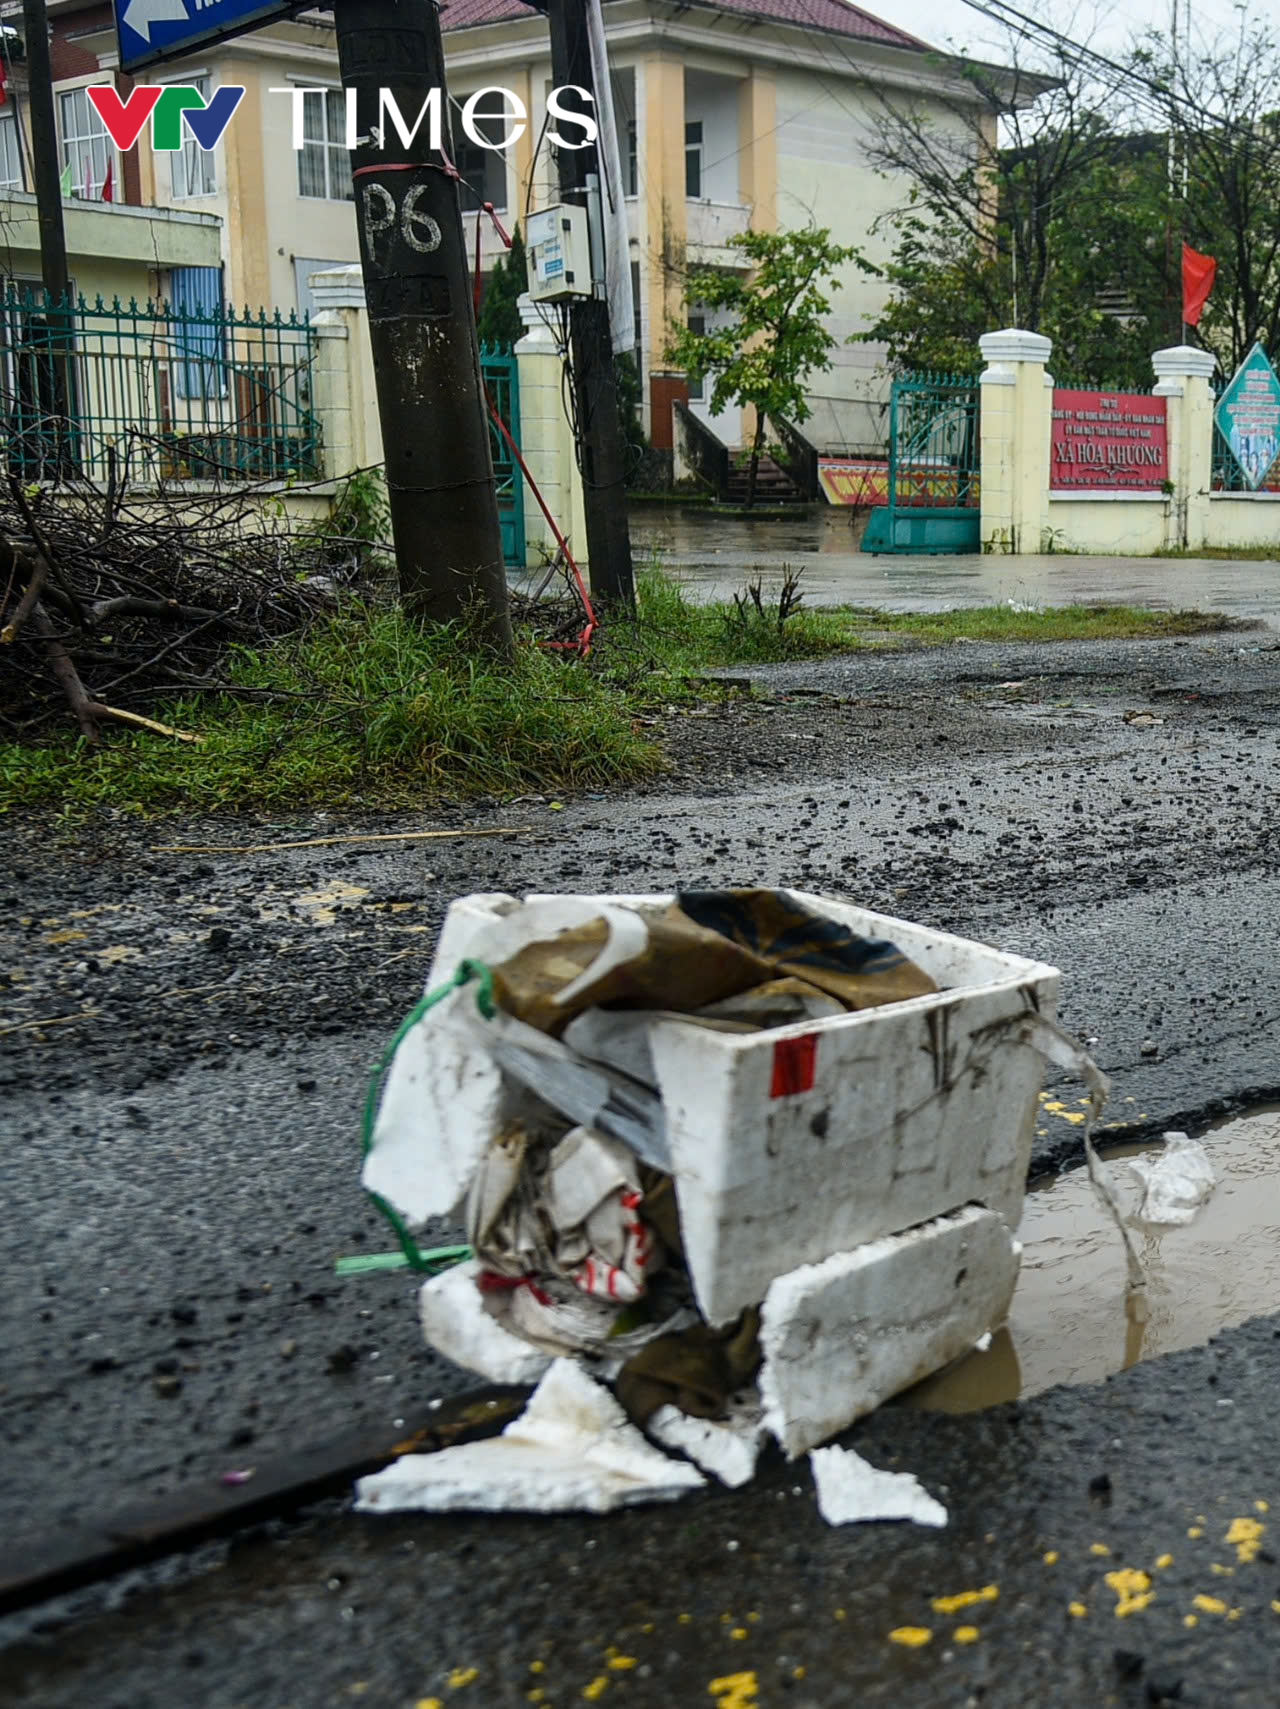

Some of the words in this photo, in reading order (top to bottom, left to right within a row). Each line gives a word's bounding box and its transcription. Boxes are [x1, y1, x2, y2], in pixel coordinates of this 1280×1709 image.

[362, 183, 442, 262] P6
[1056, 438, 1074, 463] XÃ
[1077, 438, 1105, 464] HÒA
